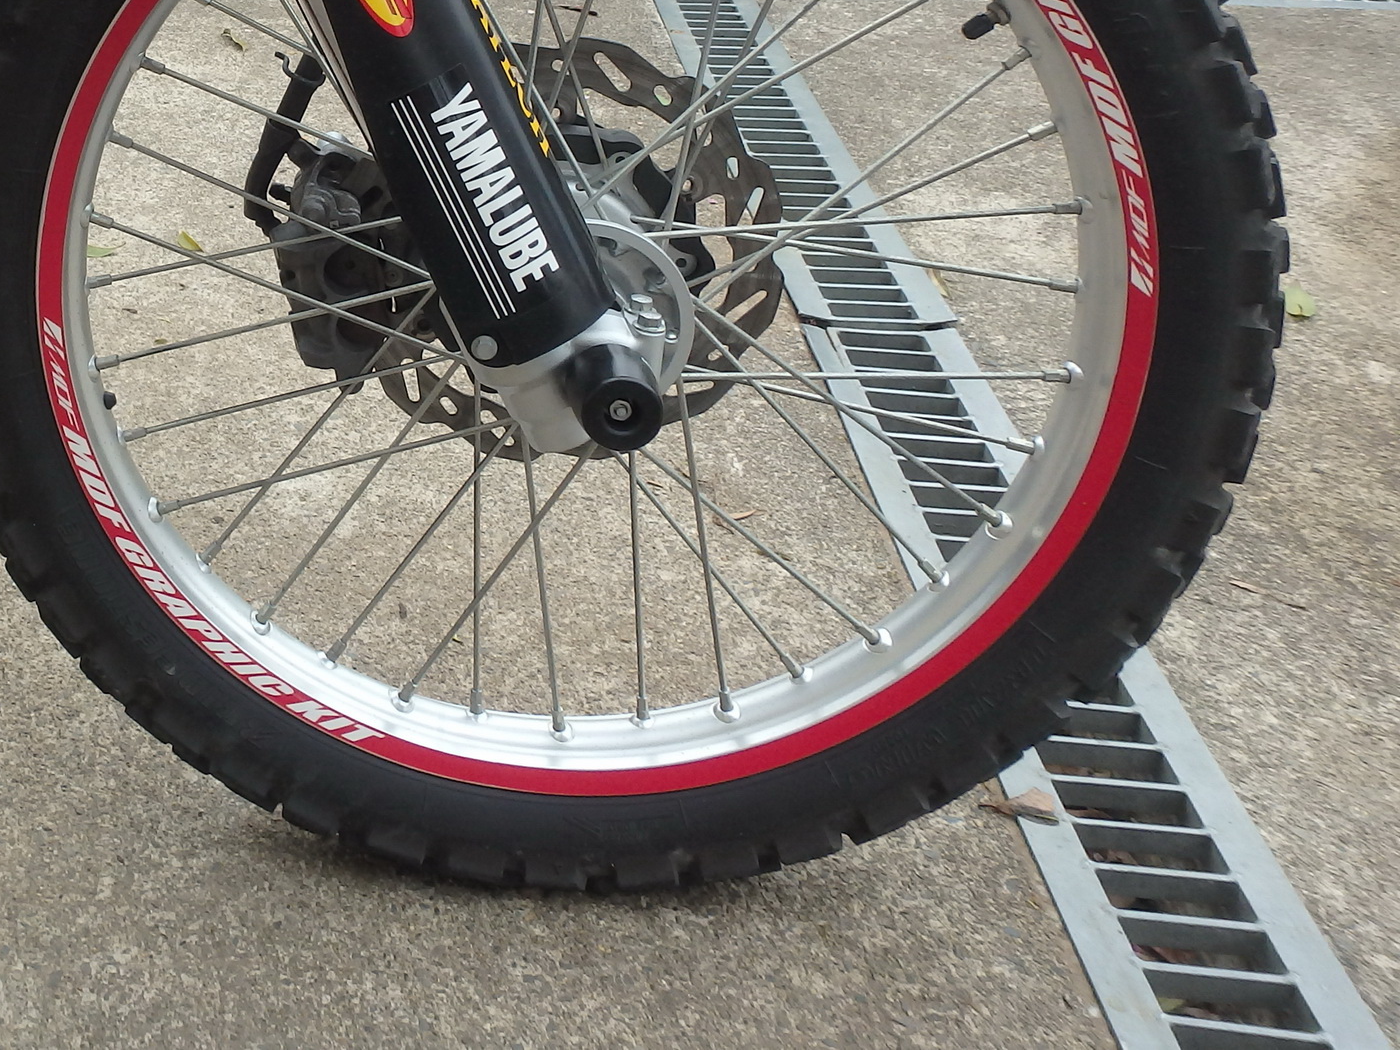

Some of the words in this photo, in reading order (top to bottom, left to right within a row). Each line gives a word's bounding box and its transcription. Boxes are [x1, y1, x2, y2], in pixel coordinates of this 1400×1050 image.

[430, 81, 561, 293] YAMALUBE
[1072, 51, 1144, 180] MDF
[62, 425, 130, 533] MDF
[114, 536, 292, 696] GRAPHIC
[286, 693, 387, 743] KIT
